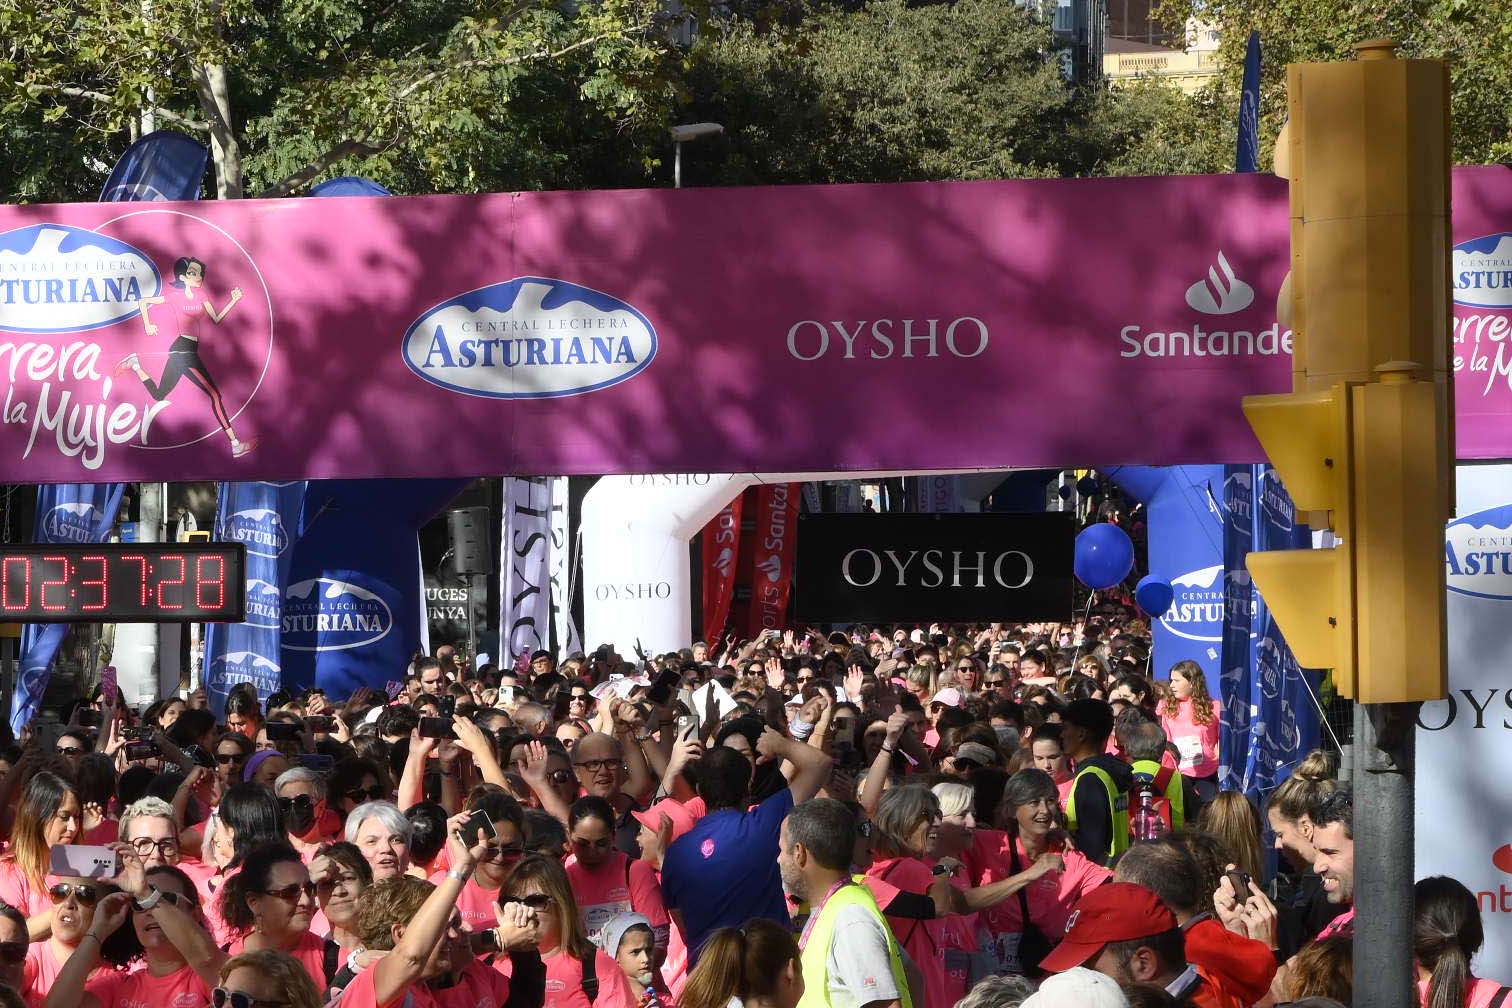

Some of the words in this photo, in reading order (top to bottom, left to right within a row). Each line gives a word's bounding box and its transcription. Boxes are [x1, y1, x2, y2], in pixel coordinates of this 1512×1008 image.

[461, 318, 540, 332] CENTRAL
[546, 316, 629, 331] LECHERA
[787, 317, 989, 361] OYSHO
[1120, 323, 1294, 357] Santande
[422, 324, 638, 368] ASTURIANA
[3, 385, 28, 425] la
[23, 375, 172, 470] Mujer
[764, 483, 787, 551] Santa
[1445, 540, 1512, 576] ASTU
[1467, 537, 1512, 546] CENT
[2, 555, 224, 610] 02:37:28
[510, 477, 548, 662] OYSH
[842, 548, 1035, 589] OYSHO
[426, 588, 468, 601] UGES
[595, 581, 672, 602] OYSHO
[761, 586, 779, 630] orts
[1182, 592, 1224, 600] CENTRA
[281, 614, 383, 633] STURIANA
[426, 607, 468, 620] UNYA
